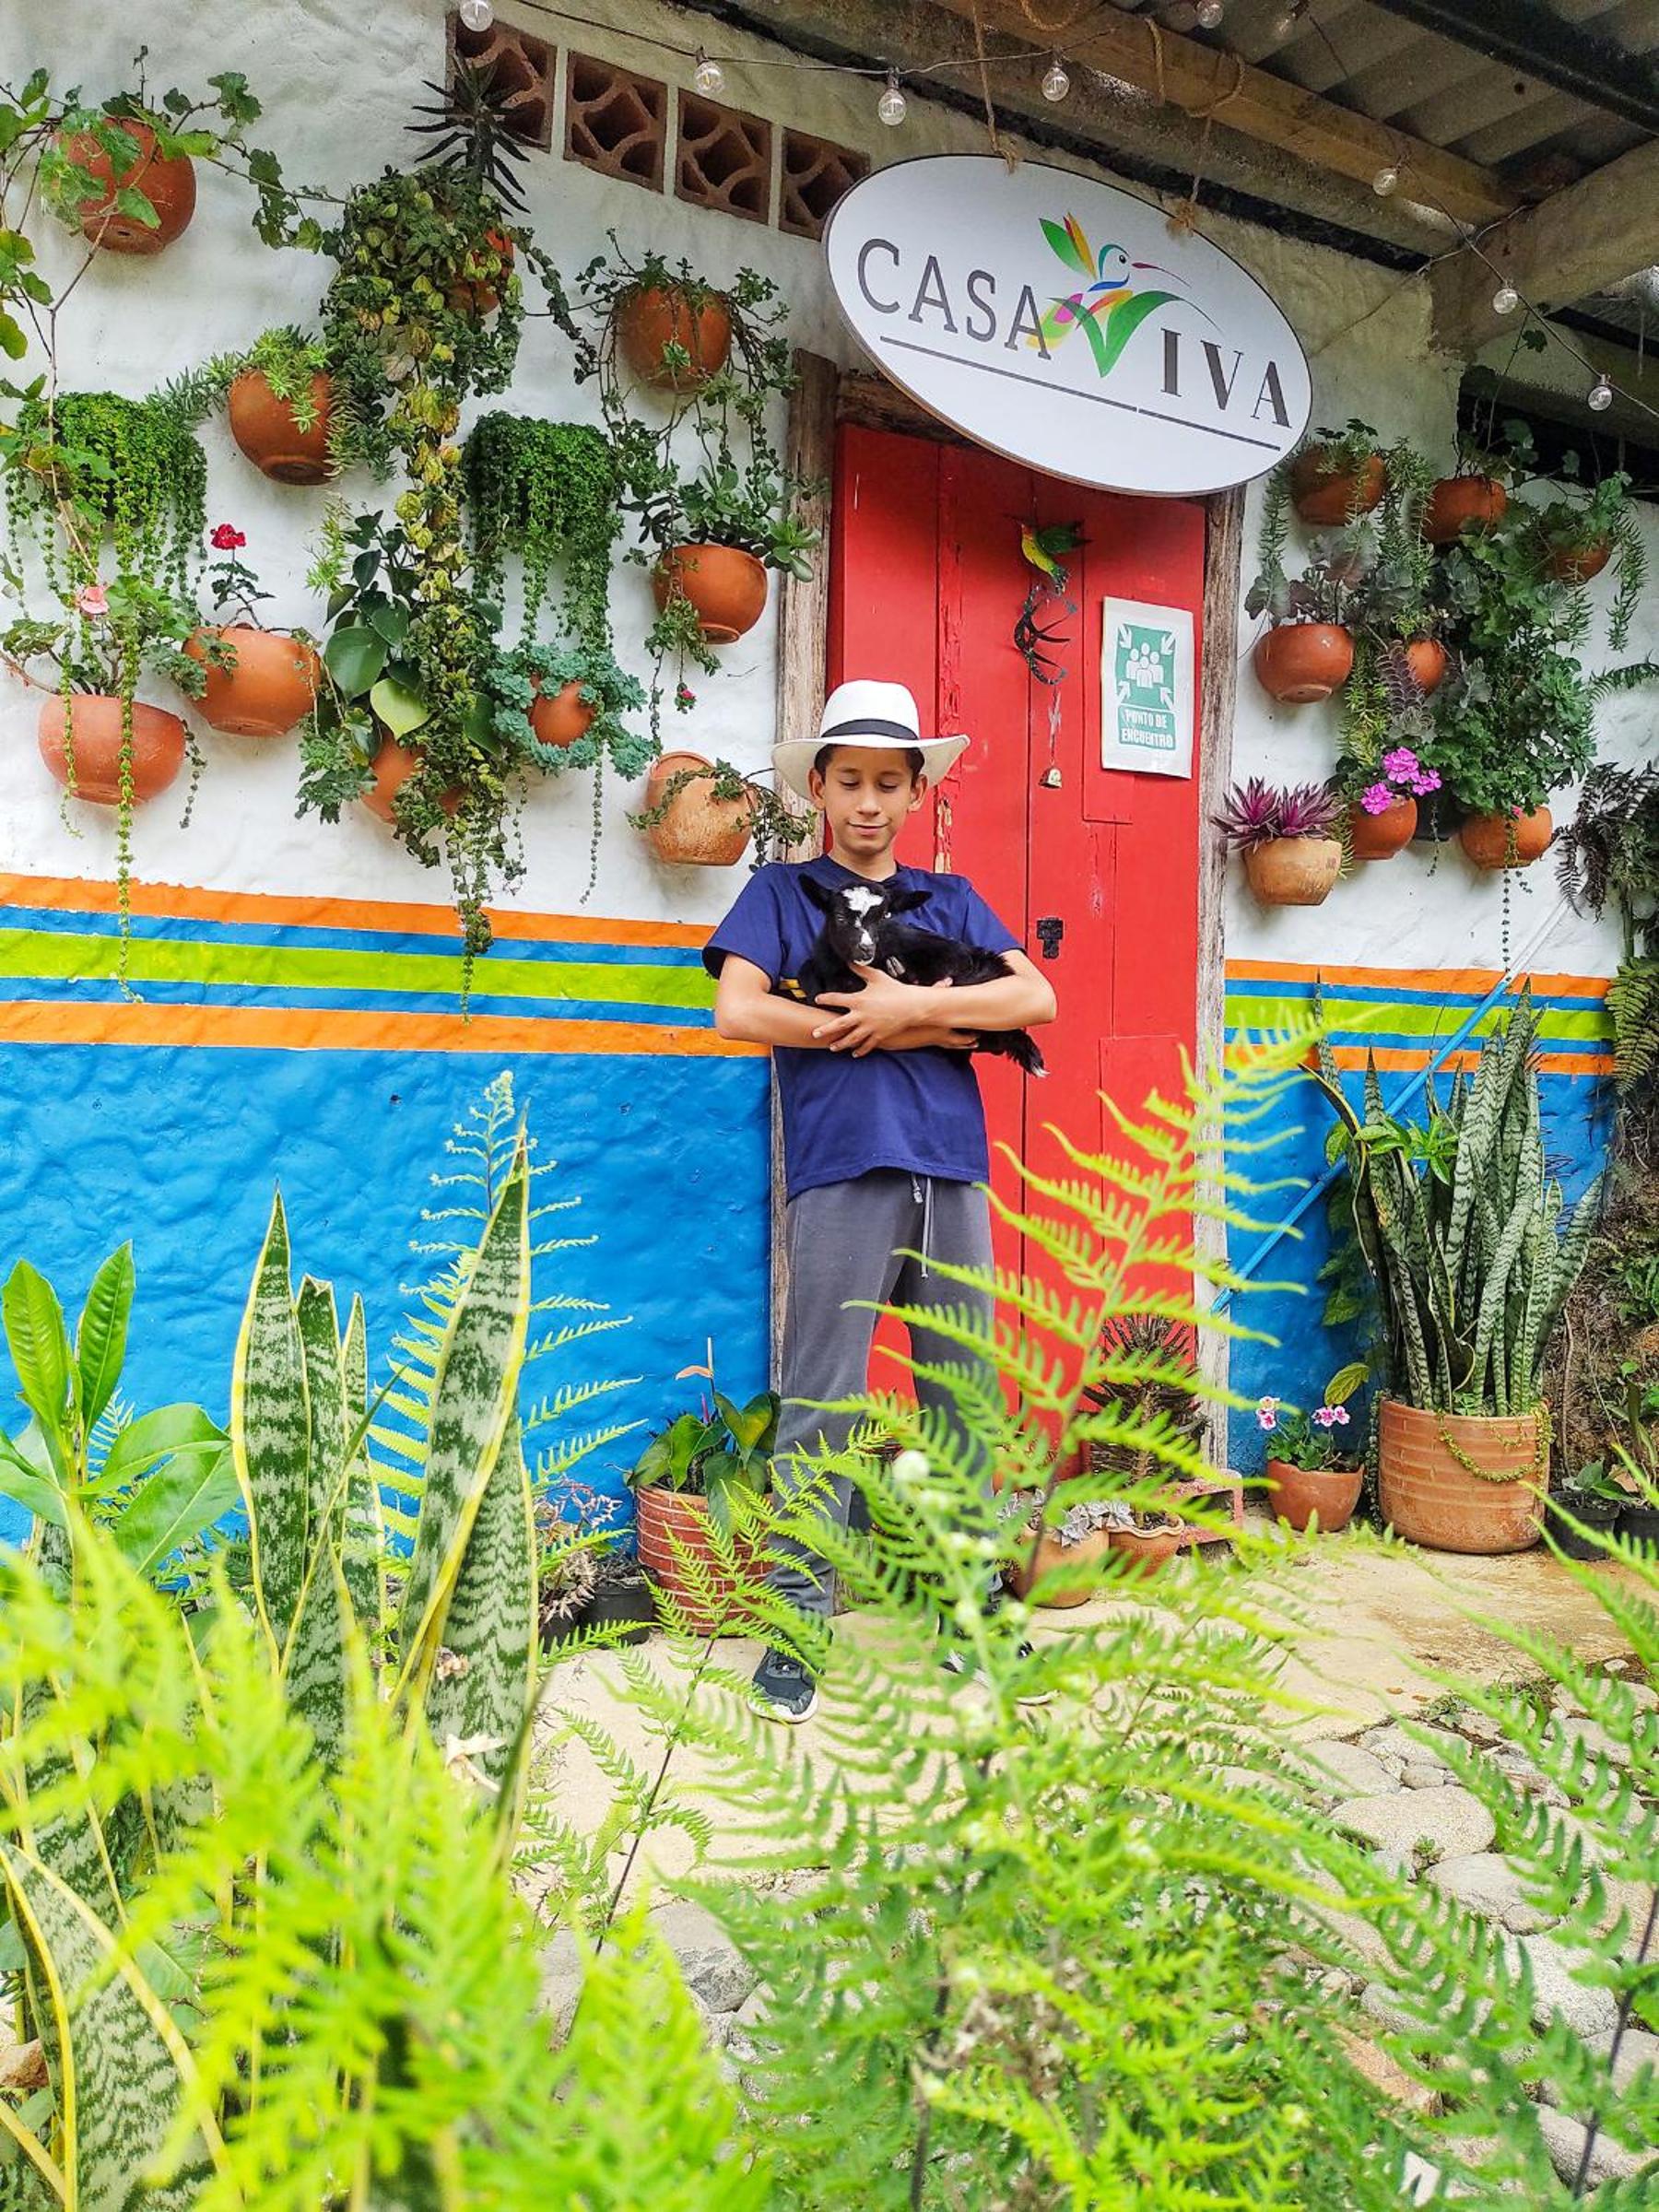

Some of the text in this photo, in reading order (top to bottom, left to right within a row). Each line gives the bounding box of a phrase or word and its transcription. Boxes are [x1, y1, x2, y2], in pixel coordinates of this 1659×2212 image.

[858, 239, 1052, 360] CASA
[1124, 709, 1167, 728] PUNTO DE
[1121, 728, 1173, 748] ENCUENTRO
